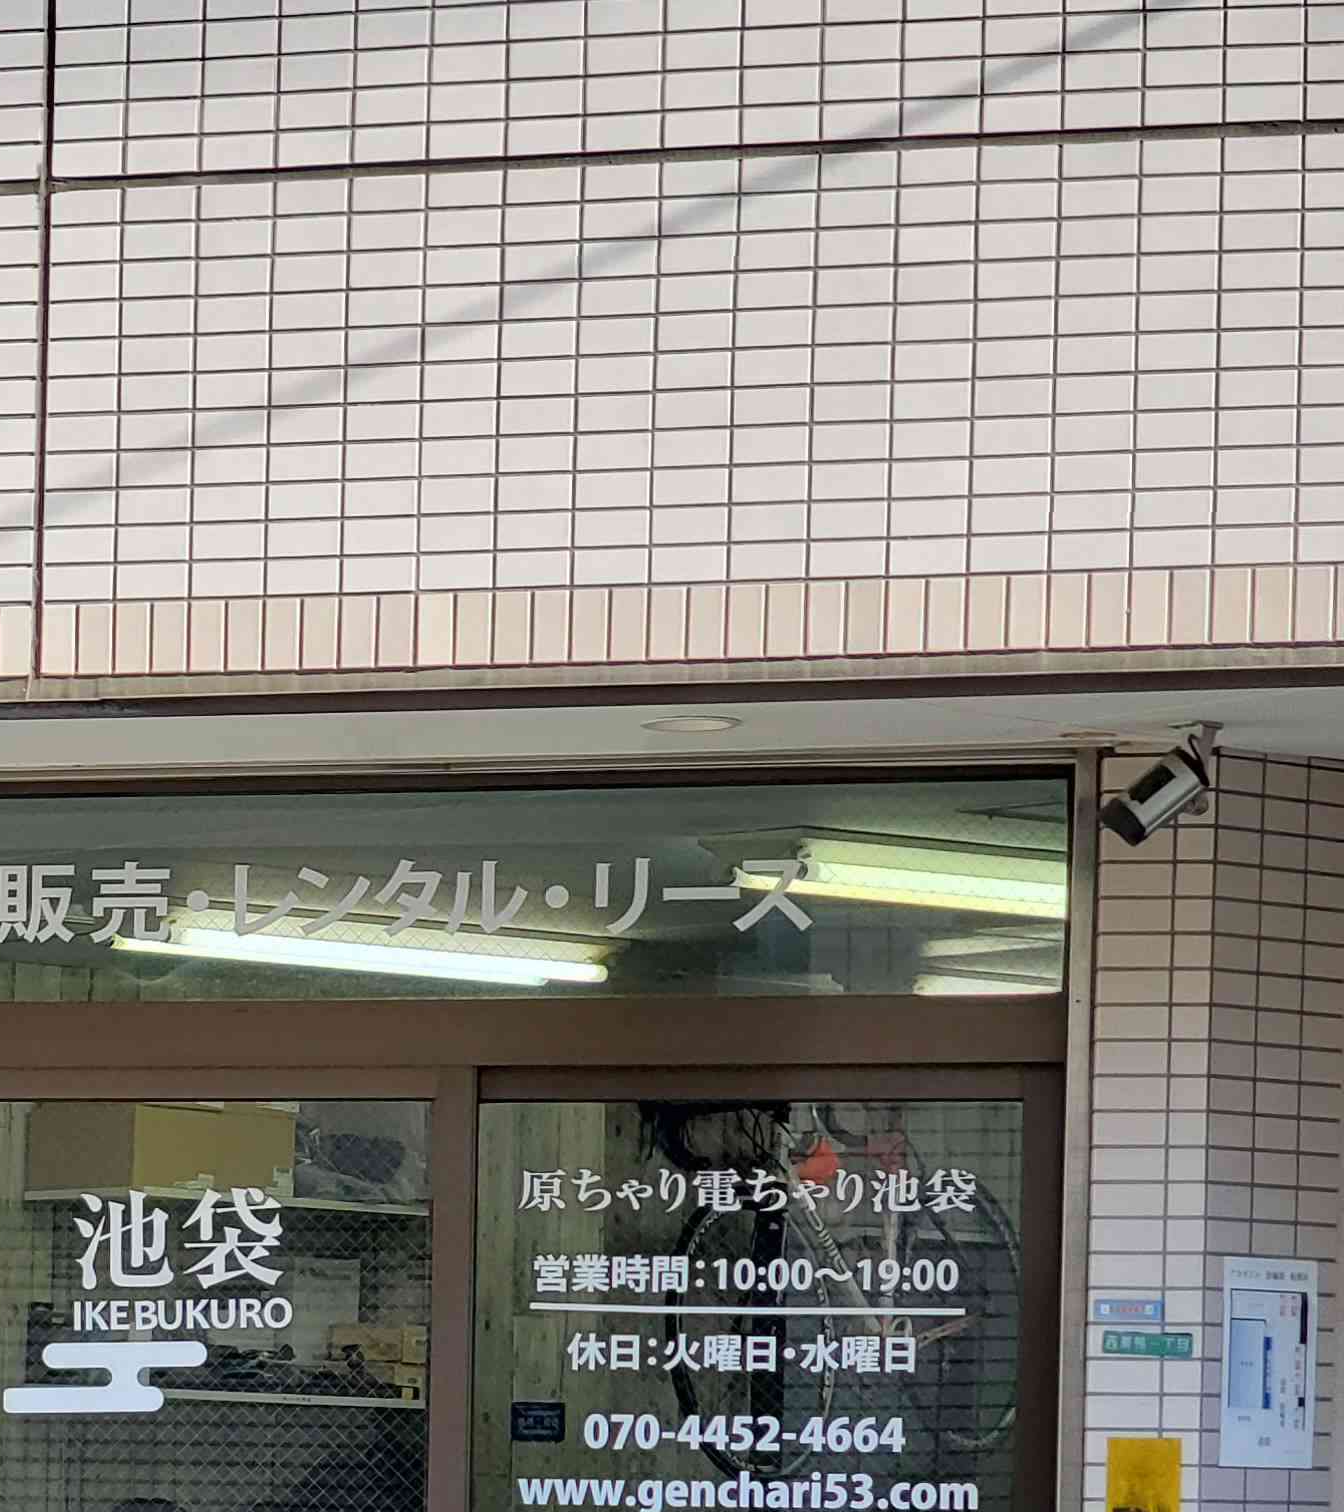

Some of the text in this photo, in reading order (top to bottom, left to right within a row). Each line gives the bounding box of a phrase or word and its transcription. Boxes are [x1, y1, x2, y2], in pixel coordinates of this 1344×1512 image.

[518, 1168, 978, 1216] 原ちゃり電ちゃり池袋
[72, 1186, 286, 1291] 池袋
[72, 1296, 293, 1331] IKEBUKURO
[584, 1414, 906, 1453] 070-4452-4664
